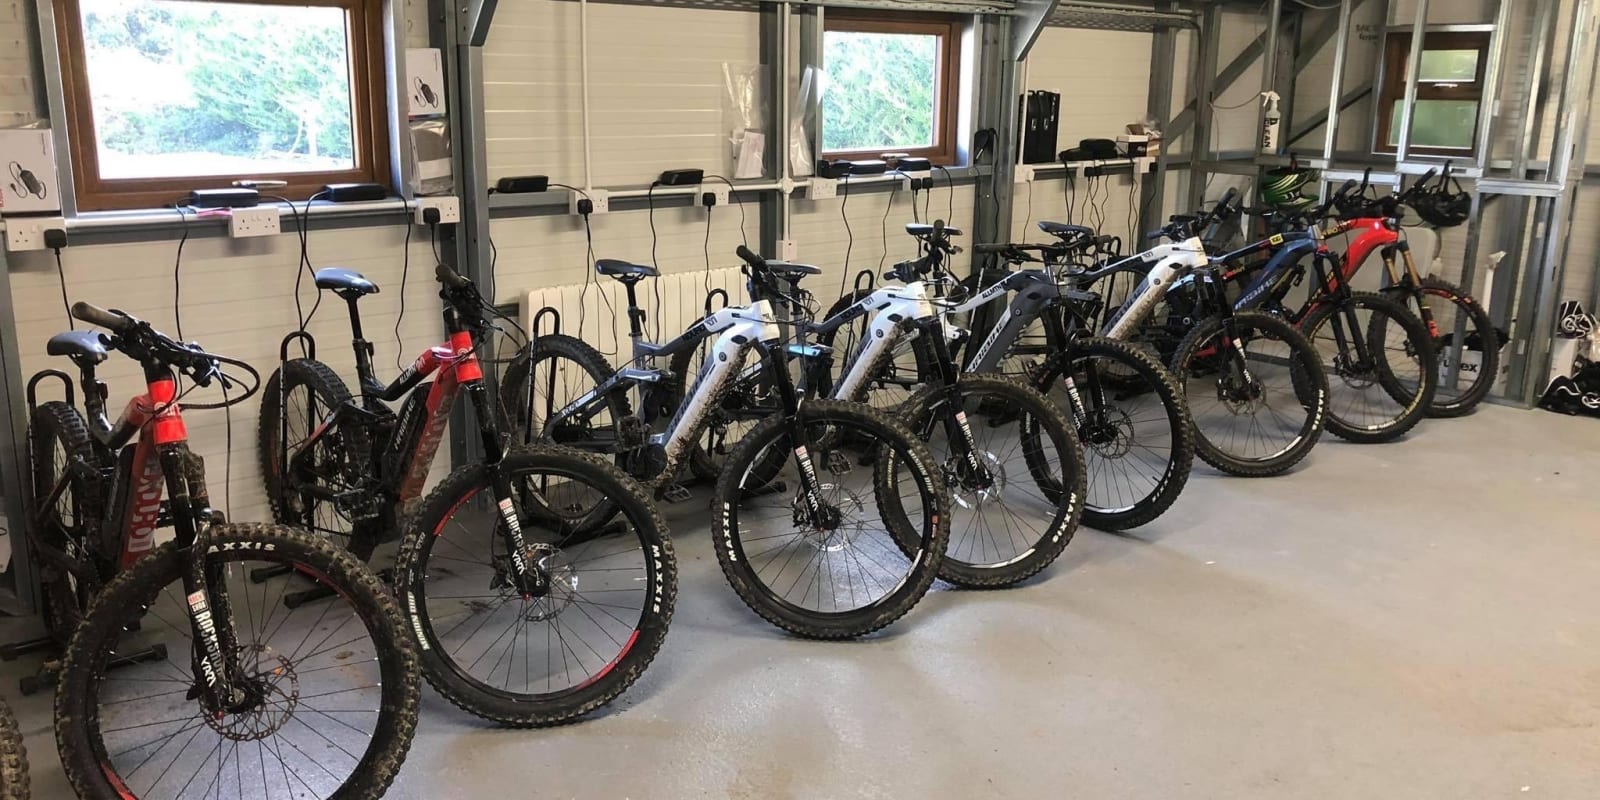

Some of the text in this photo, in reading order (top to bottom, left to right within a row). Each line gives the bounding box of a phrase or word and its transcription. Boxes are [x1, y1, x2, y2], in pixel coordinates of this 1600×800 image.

[1444, 360, 1478, 372] uex
[1311, 389, 1324, 431] MAXXIS
[723, 502, 736, 562] MAXXIS
[1052, 493, 1076, 543] MAXXIS
[208, 542, 275, 553] AXXIS
[652, 544, 664, 613] MAXXIS
[410, 614, 430, 650] MINION
[201, 654, 217, 688] YARI
